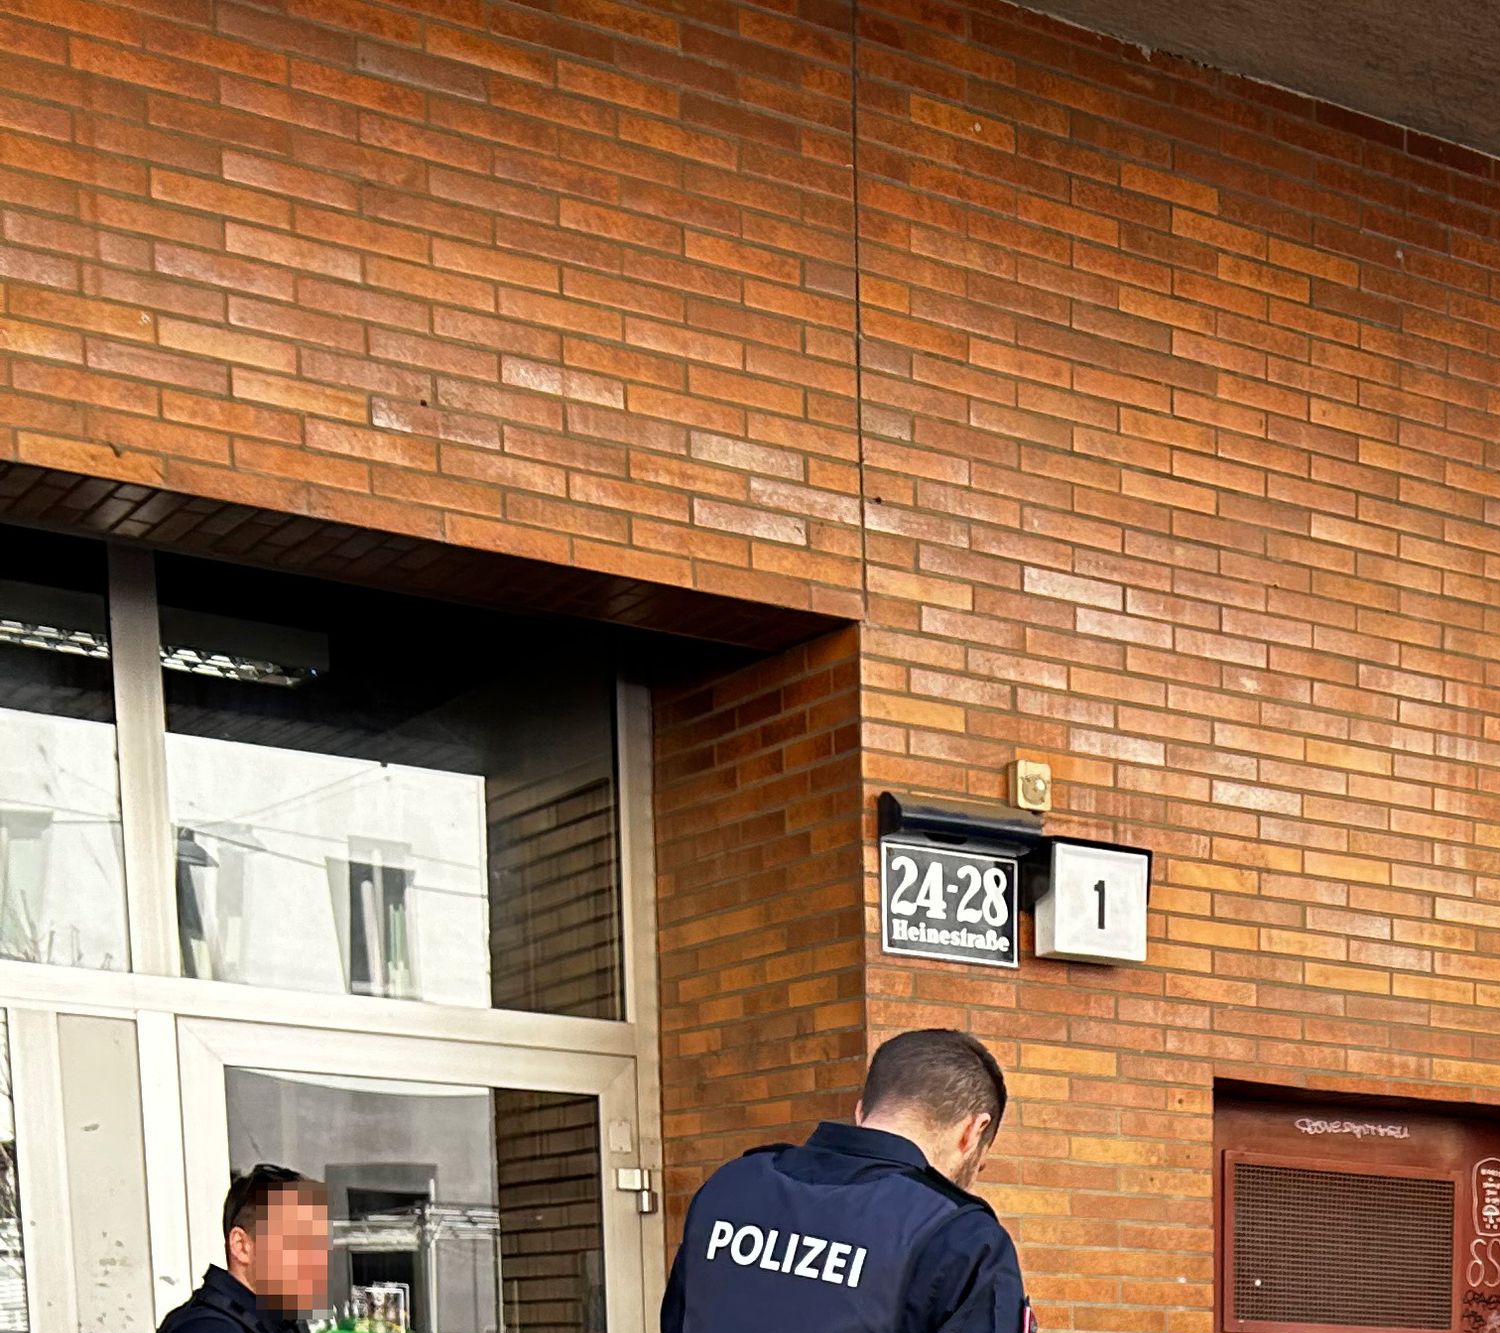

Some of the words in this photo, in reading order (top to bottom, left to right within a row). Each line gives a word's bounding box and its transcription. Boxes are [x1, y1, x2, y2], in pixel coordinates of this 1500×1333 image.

[889, 855, 1009, 928] 24-28
[1093, 879, 1107, 930] 1
[891, 918, 1011, 953] Heinestraße
[706, 1220, 868, 1288] POLIZEI
